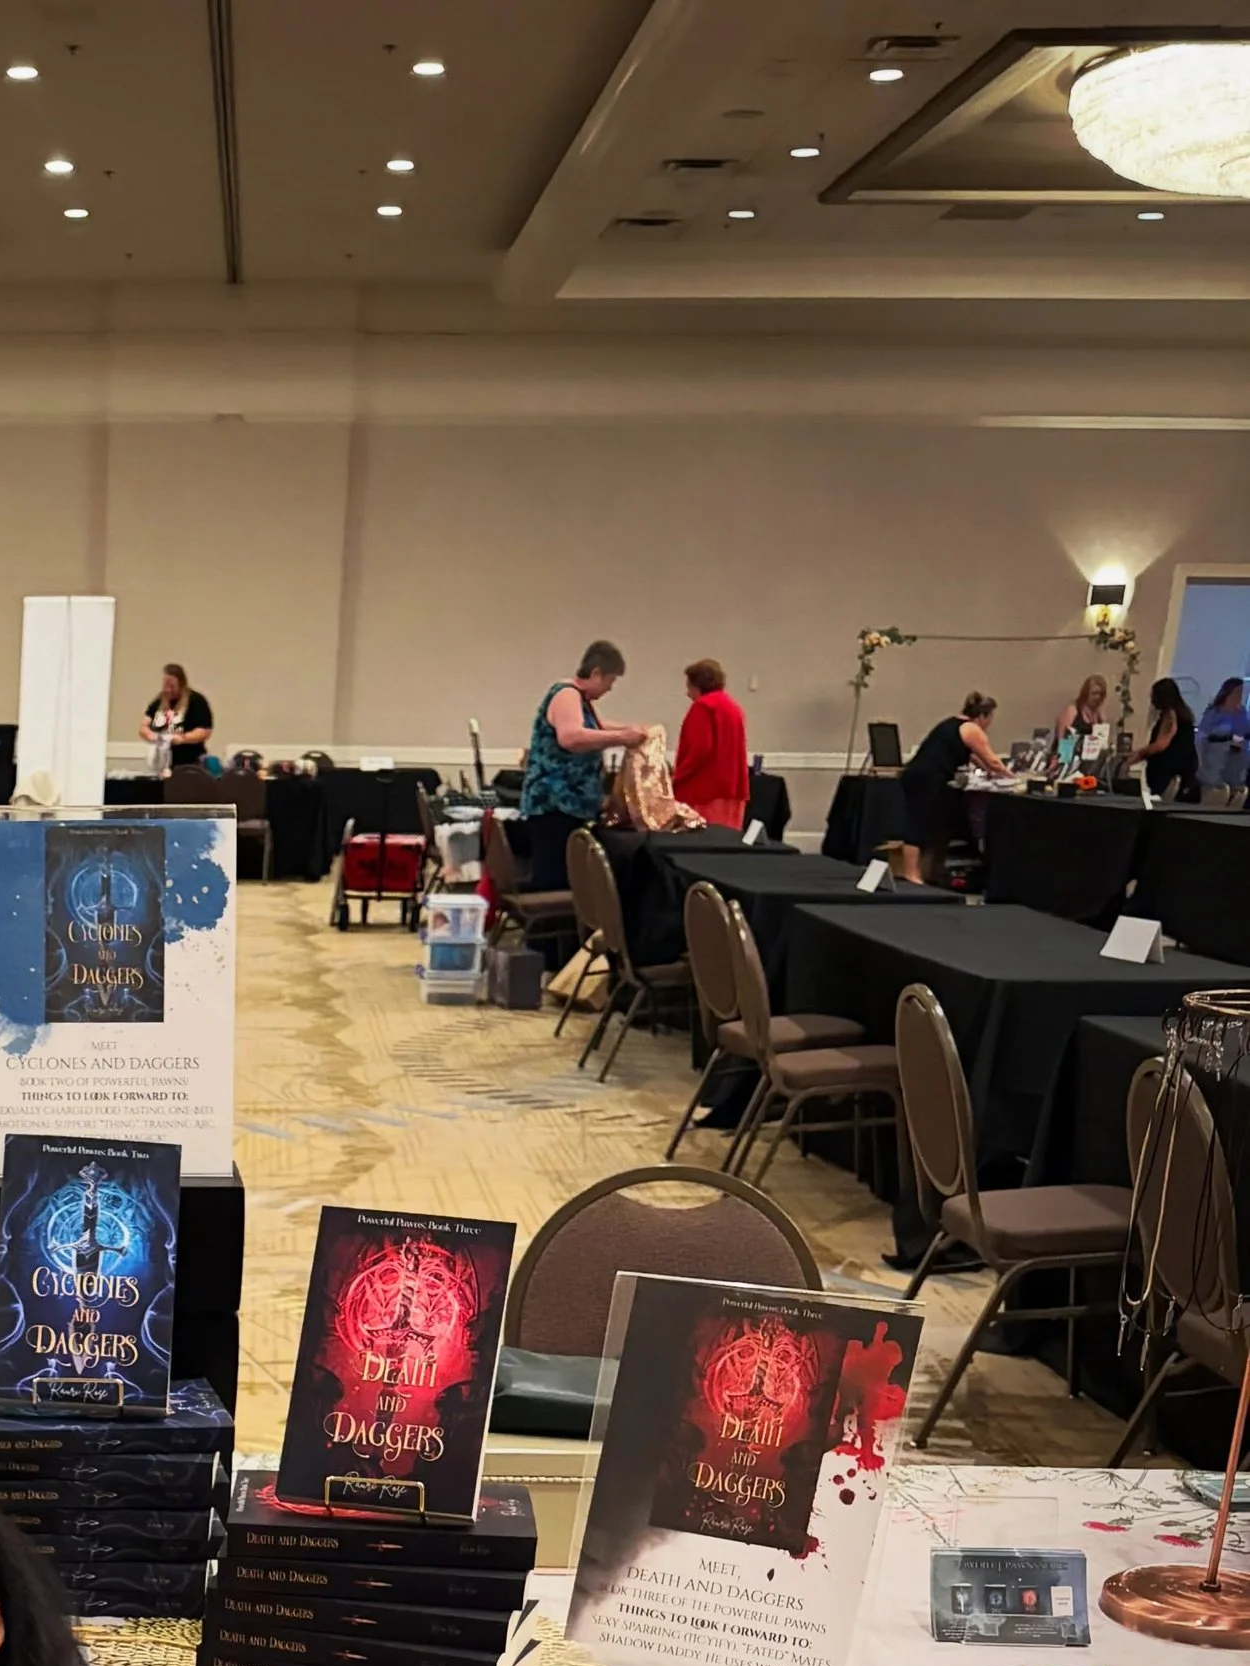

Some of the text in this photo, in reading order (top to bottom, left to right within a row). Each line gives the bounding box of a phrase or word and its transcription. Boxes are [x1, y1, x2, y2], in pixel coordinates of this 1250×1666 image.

[70, 963, 144, 990] DAGGERS
[91, 1040, 118, 1051] MEET
[5, 1056, 200, 1070] CYCLONES AND DAGGERS
[19, 1076, 47, 1087] BOOK
[49, 1076, 74, 1087] TWO
[75, 1076, 91, 1087] OF
[92, 1076, 149, 1087] POWERFUL
[21, 1091, 64, 1101] THINGS
[66, 1091, 82, 1101] TO
[83, 1091, 110, 1101] LOOK
[113, 1091, 168, 1101] FORWARD
[43, 1105, 93, 1115] CHARGED
[54, 1119, 97, 1129] SUPPORT
[143, 1119, 192, 1129] TRAINING
[42, 1143, 77, 1154] Powerful
[107, 1148, 129, 1158] Book
[132, 1150, 149, 1160] Two
[357, 1213, 396, 1228] Powerful
[428, 1220, 451, 1233] Book
[454, 1222, 482, 1235] Three
[32, 1266, 140, 1307] CYCLONES
[72, 1307, 100, 1324] AND
[722, 1298, 753, 1310] Powerful
[780, 1304, 799, 1316] Book
[802, 1308, 823, 1320] Three
[26, 1324, 139, 1368] DAGGERS
[358, 1350, 438, 1389] DEATH
[377, 1395, 407, 1413] AND
[324, 1411, 444, 1461] DAGGERS
[720, 1412, 784, 1448] DEATH
[730, 1451, 758, 1467] AND
[688, 1462, 786, 1507] DAGGERS
[246, 1531, 339, 1549] DEATH AND DAGGERS
[236, 1566, 328, 1585] DEATH AND DAGGERS
[626, 1566, 805, 1611] DEATH AND DAGGERS
[224, 1597, 314, 1619] DEATH AND DAGGERS
[630, 1587, 669, 1604] THREE
[671, 1595, 687, 1607] OF
[713, 1603, 780, 1625] POWERFUL
[784, 1616, 828, 1635] PAWNS
[592, 1614, 620, 1628] SEXY
[621, 1620, 681, 1640] SPARRING
[619, 1603, 813, 1650] THINGS TO LOOK FORWARD TO:
[219, 1629, 307, 1653] DEATH AND DAGGERS
[599, 1631, 655, 1651] SHADOW
[706, 1652, 722, 1665] HE
